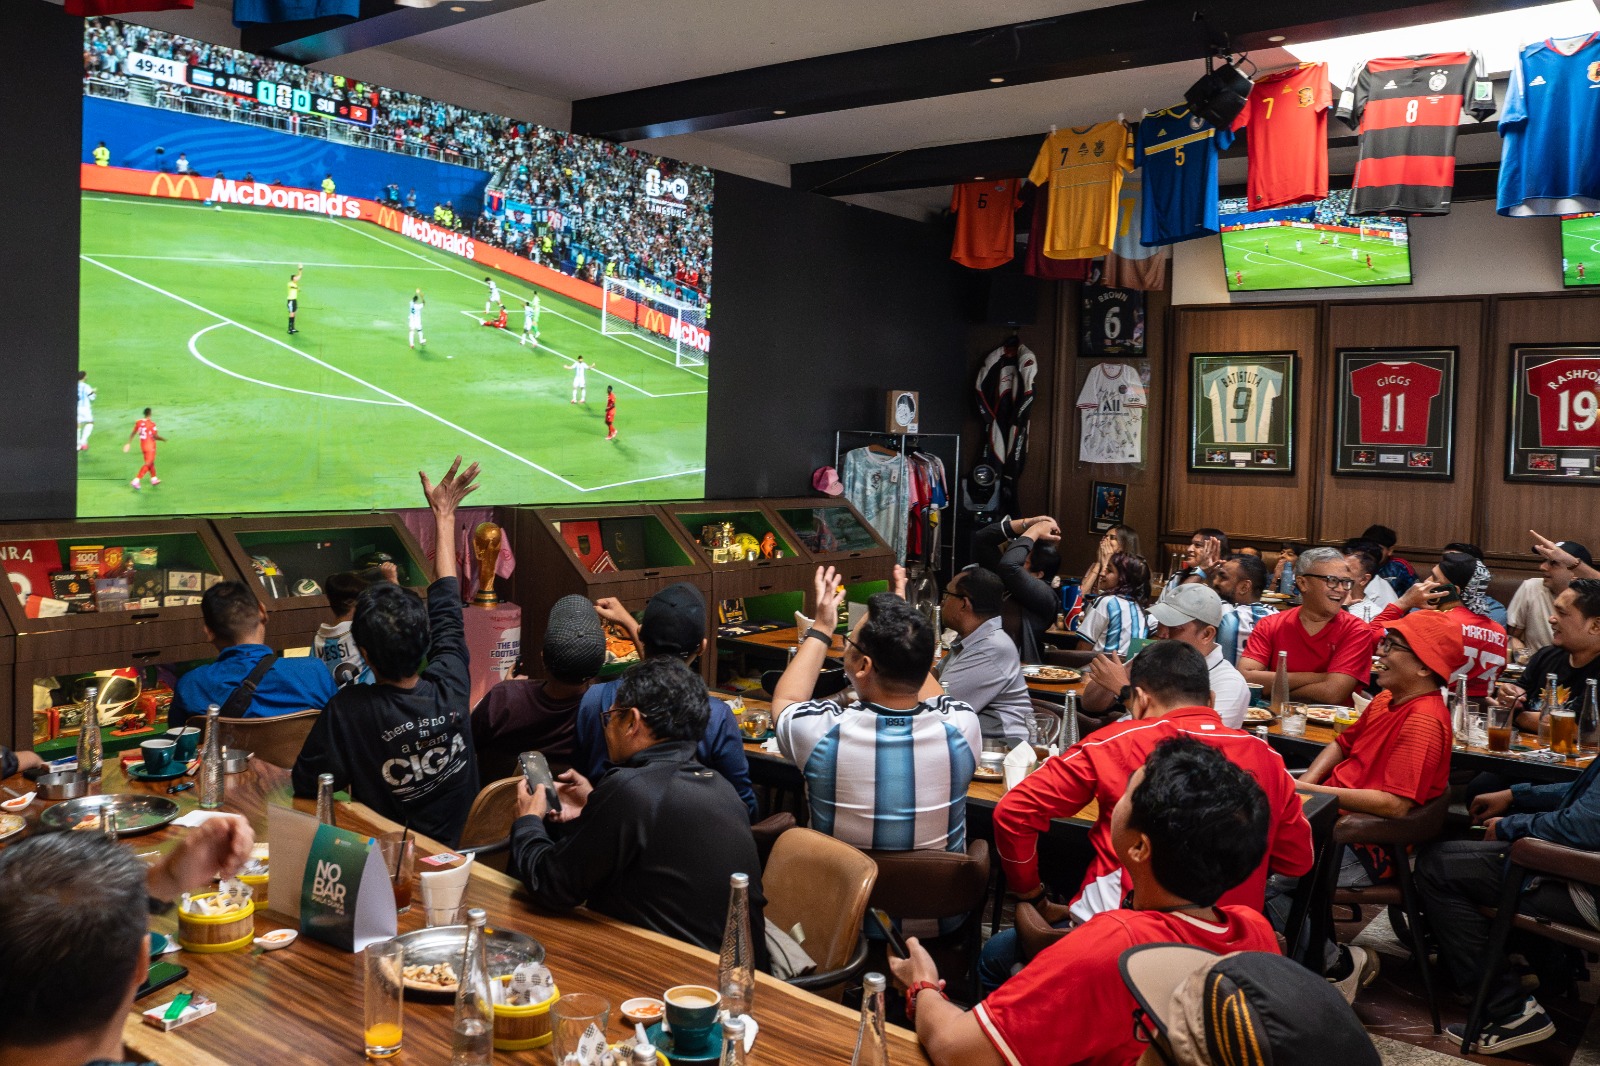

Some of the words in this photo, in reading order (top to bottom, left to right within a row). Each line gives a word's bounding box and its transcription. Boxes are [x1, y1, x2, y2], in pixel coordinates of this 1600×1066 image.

[134, 58, 174, 78] 49:41
[227, 77, 253, 94] ARG
[1262, 97, 1275, 120] 7
[1405, 99, 1419, 123] 8
[1060, 147, 1069, 166] 7
[1174, 145, 1185, 166] 5
[209, 179, 361, 218] McDonald's
[977, 193, 989, 209] 6
[402, 214, 475, 259] McDonald's
[1104, 306, 1121, 339] 6
[1376, 375, 1412, 387] GIGGS
[1230, 386, 1252, 423] 9
[1381, 393, 1405, 432] 11
[1557, 389, 1598, 431] 19
[381, 721, 415, 741] there
[418, 717, 430, 728] is
[431, 715, 446, 727] no
[419, 728, 430, 738] in
[884, 717, 906, 727] 1893
[401, 743, 411, 754] a
[315, 858, 342, 883] NO
[312, 877, 347, 901] BAR
